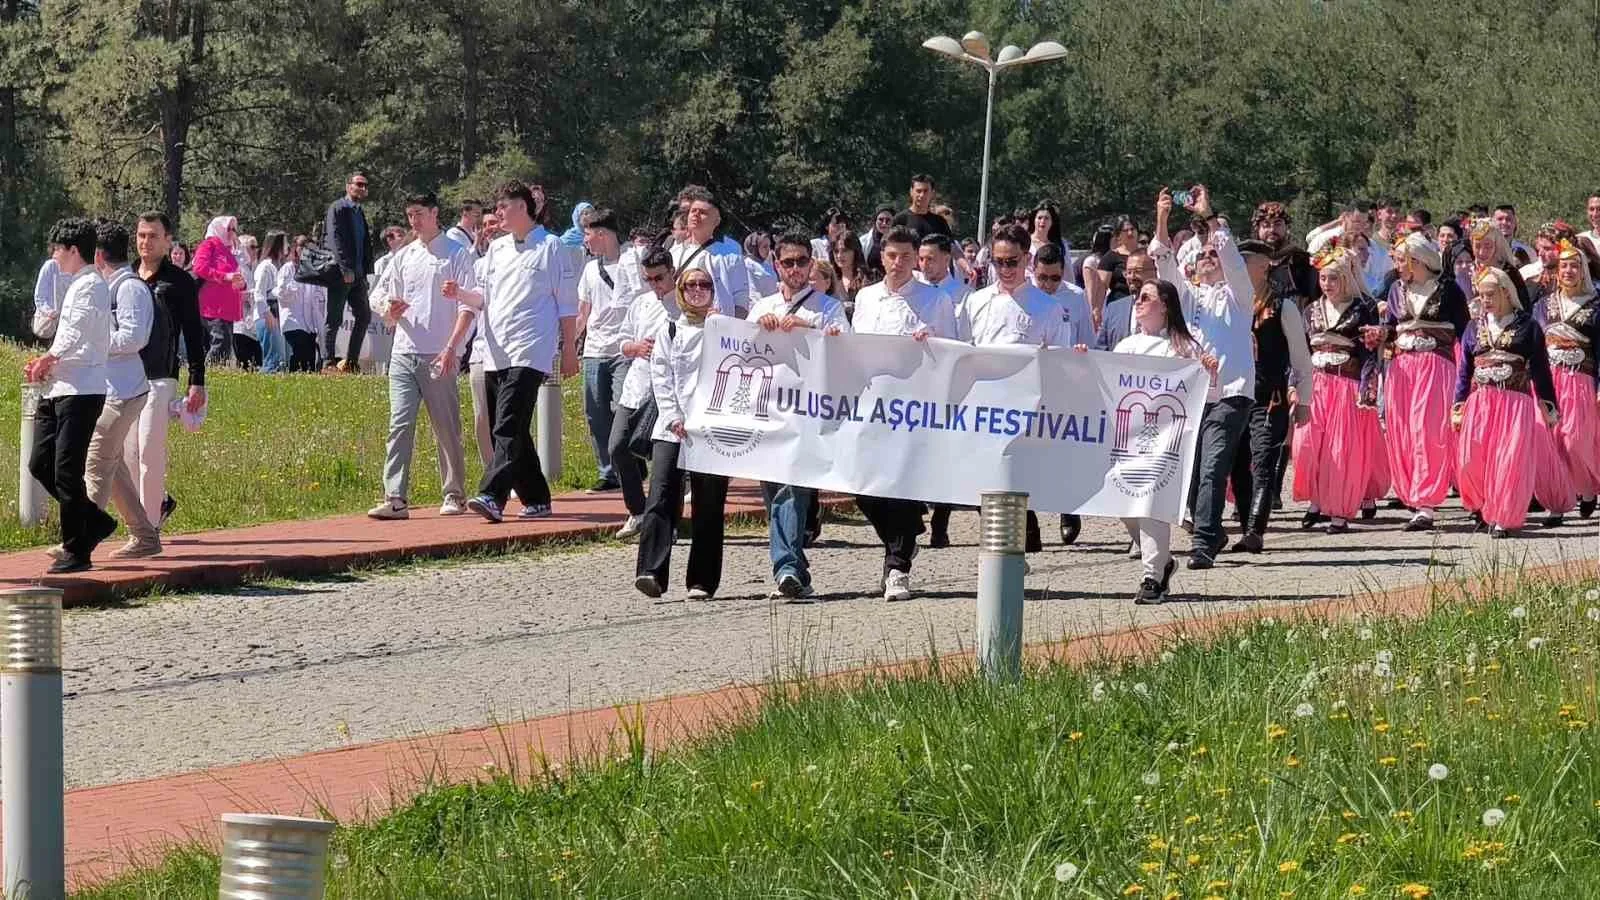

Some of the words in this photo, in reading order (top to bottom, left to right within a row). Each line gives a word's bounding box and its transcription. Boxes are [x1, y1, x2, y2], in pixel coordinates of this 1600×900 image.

[720, 336, 775, 355] MUĞLA
[1119, 373, 1188, 393] MUĞLA
[777, 387, 865, 422] ULUSAL
[869, 397, 968, 432] AŞÇILIK
[974, 404, 1106, 444] FESTİVALİ
